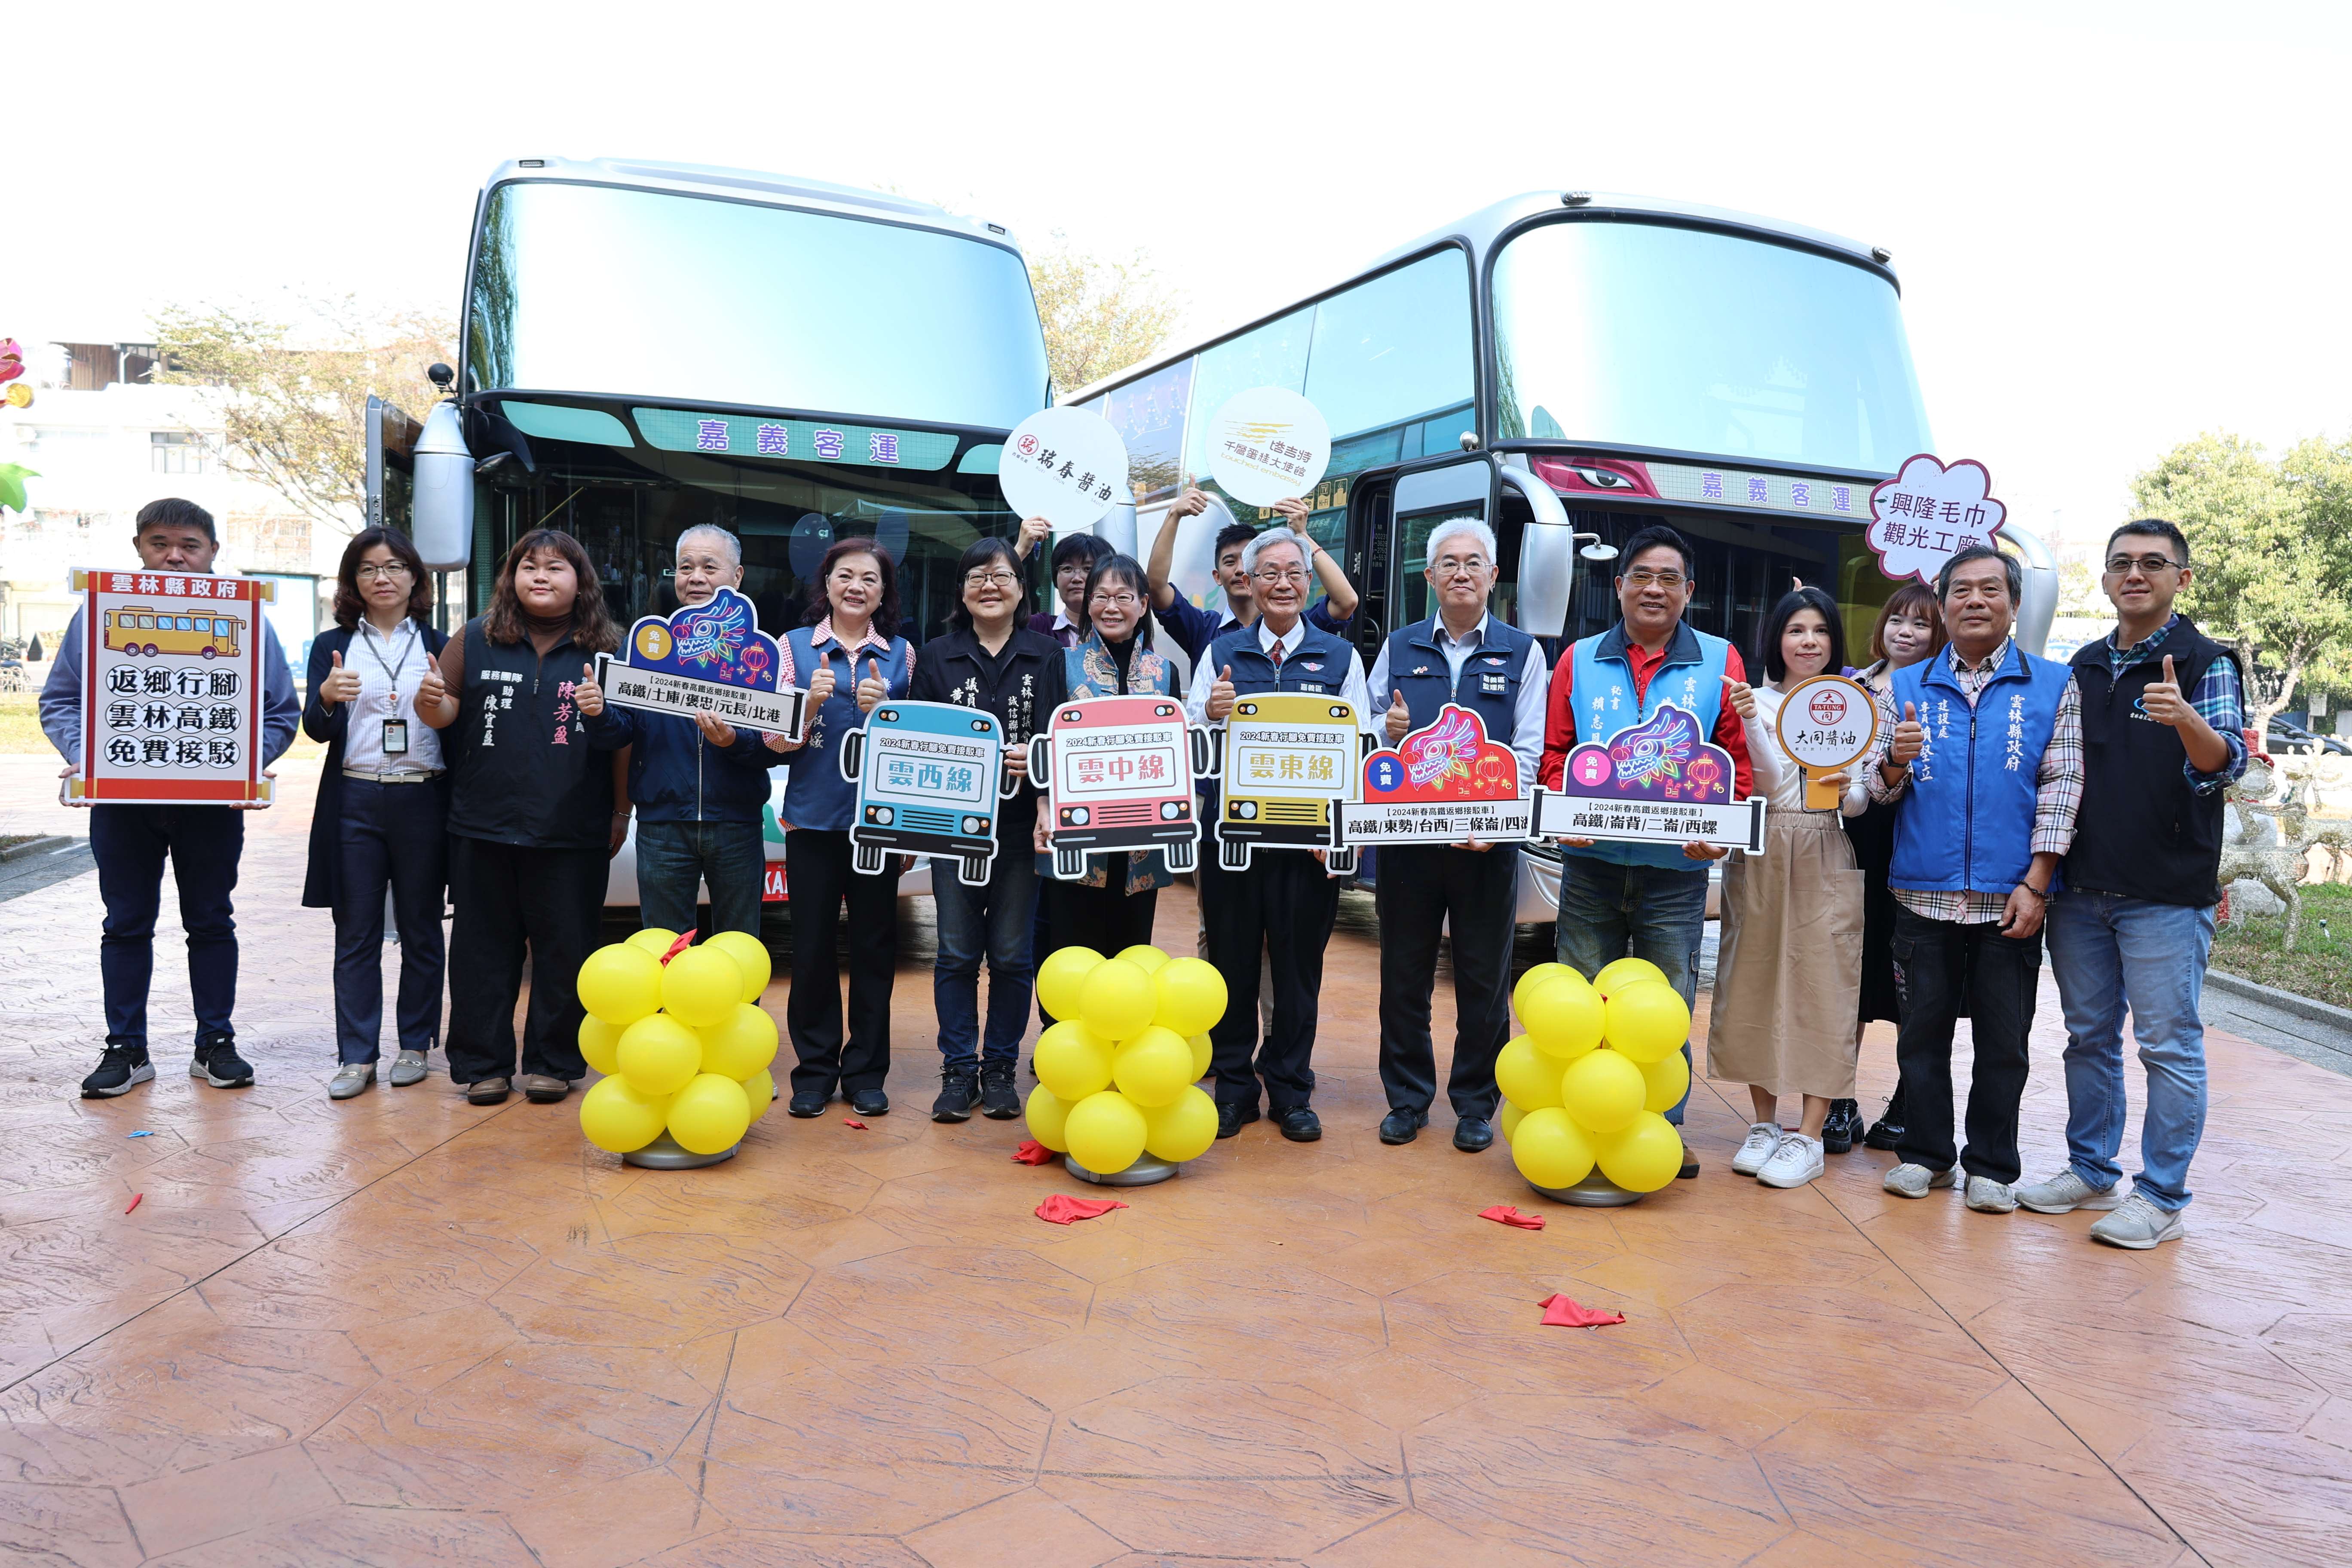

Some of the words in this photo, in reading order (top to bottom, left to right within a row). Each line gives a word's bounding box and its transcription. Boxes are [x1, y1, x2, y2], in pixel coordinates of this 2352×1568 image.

[696, 419, 900, 464] 嘉義客運
[1221, 452, 1259, 470] touched
[1260, 467, 1302, 487] embassy
[1224, 441, 1306, 477] 千層蛋糕大使館
[1037, 449, 1112, 501] 瑞春醬油
[1053, 476, 1066, 485] CHUN
[1090, 498, 1105, 508] SAUCE
[1701, 471, 1852, 513] 嘉義客運
[1890, 492, 1986, 528] 興隆毛巾
[1883, 521, 1981, 554] 觀光工廠
[111, 574, 238, 598] 雲林縣政府
[647, 630, 660, 654] 免費
[109, 668, 237, 697] 返鄉行腳
[481, 670, 523, 683] 服務團隊
[1300, 683, 1322, 692] 嘉義區
[1482, 683, 1505, 691] 監理所
[1483, 675, 1505, 683] 嘉義區
[500, 686, 514, 709] 助理
[965, 677, 979, 708] 議員
[109, 703, 237, 732] 雲林高鐵
[482, 695, 499, 746] 陳宜盈
[551, 681, 576, 745] 陳芳盈
[1008, 695, 1019, 743] 誠信聯盟
[1937, 698, 1951, 739] 建設處
[880, 738, 985, 757] 2024新春行腳免費接駁車
[1066, 732, 1172, 747] 2024新春行腳免費接駁車
[1240, 731, 1344, 744] 2024新春行腳免費接駁車
[1795, 729, 1856, 746] 大同醬油
[2004, 694, 2025, 772] 雲林縣政府
[108, 739, 236, 766] 免費接駁
[1250, 753, 1333, 781] 雲東線
[888, 760, 972, 792] 雲西線
[1078, 754, 1164, 784] 雲中線
[1380, 762, 1392, 785] 免費
[1585, 756, 1598, 780] 免費
[1573, 813, 1717, 835] 高鐵/崙背/二崙/西螺
